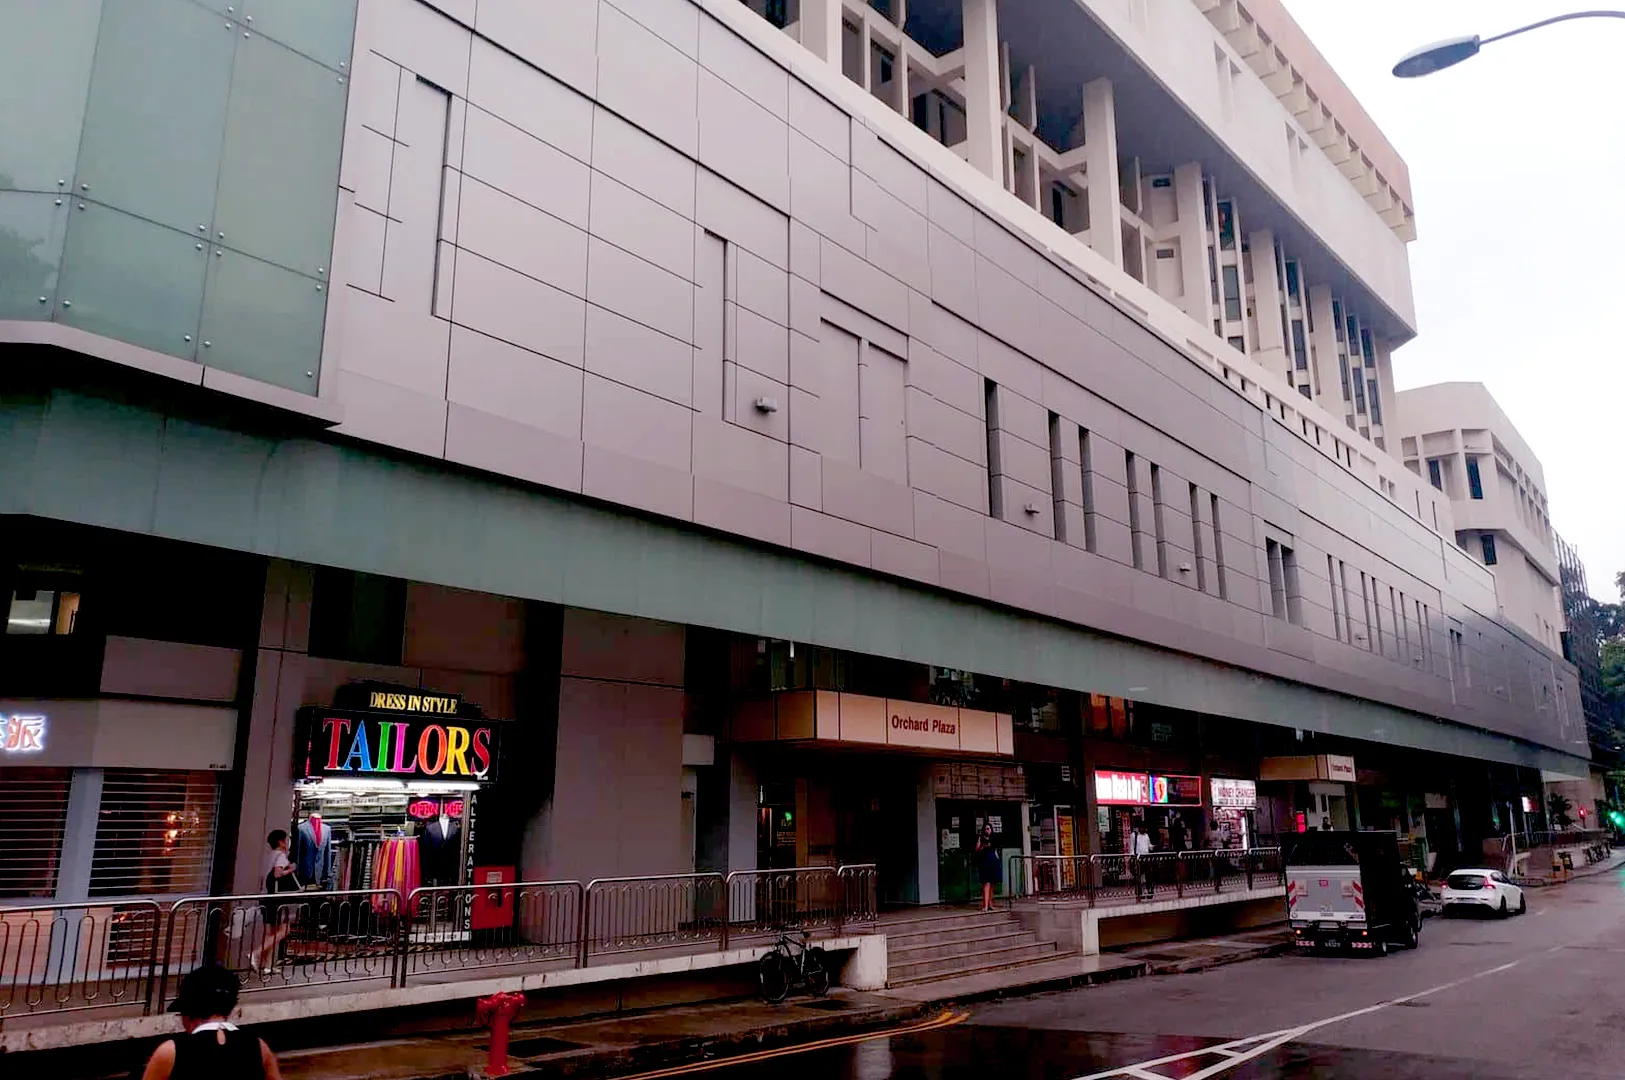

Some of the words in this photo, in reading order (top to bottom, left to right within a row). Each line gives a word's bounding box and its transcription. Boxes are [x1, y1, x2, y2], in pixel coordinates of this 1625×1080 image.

[370, 691, 406, 710] DRESS
[407, 695, 422, 711] IN
[422, 696, 458, 714] STYLE
[891, 714, 929, 732] Orchard
[932, 719, 956, 735] Plaza
[322, 717, 491, 776] TAILORS
[409, 802, 439, 817] OPEN
